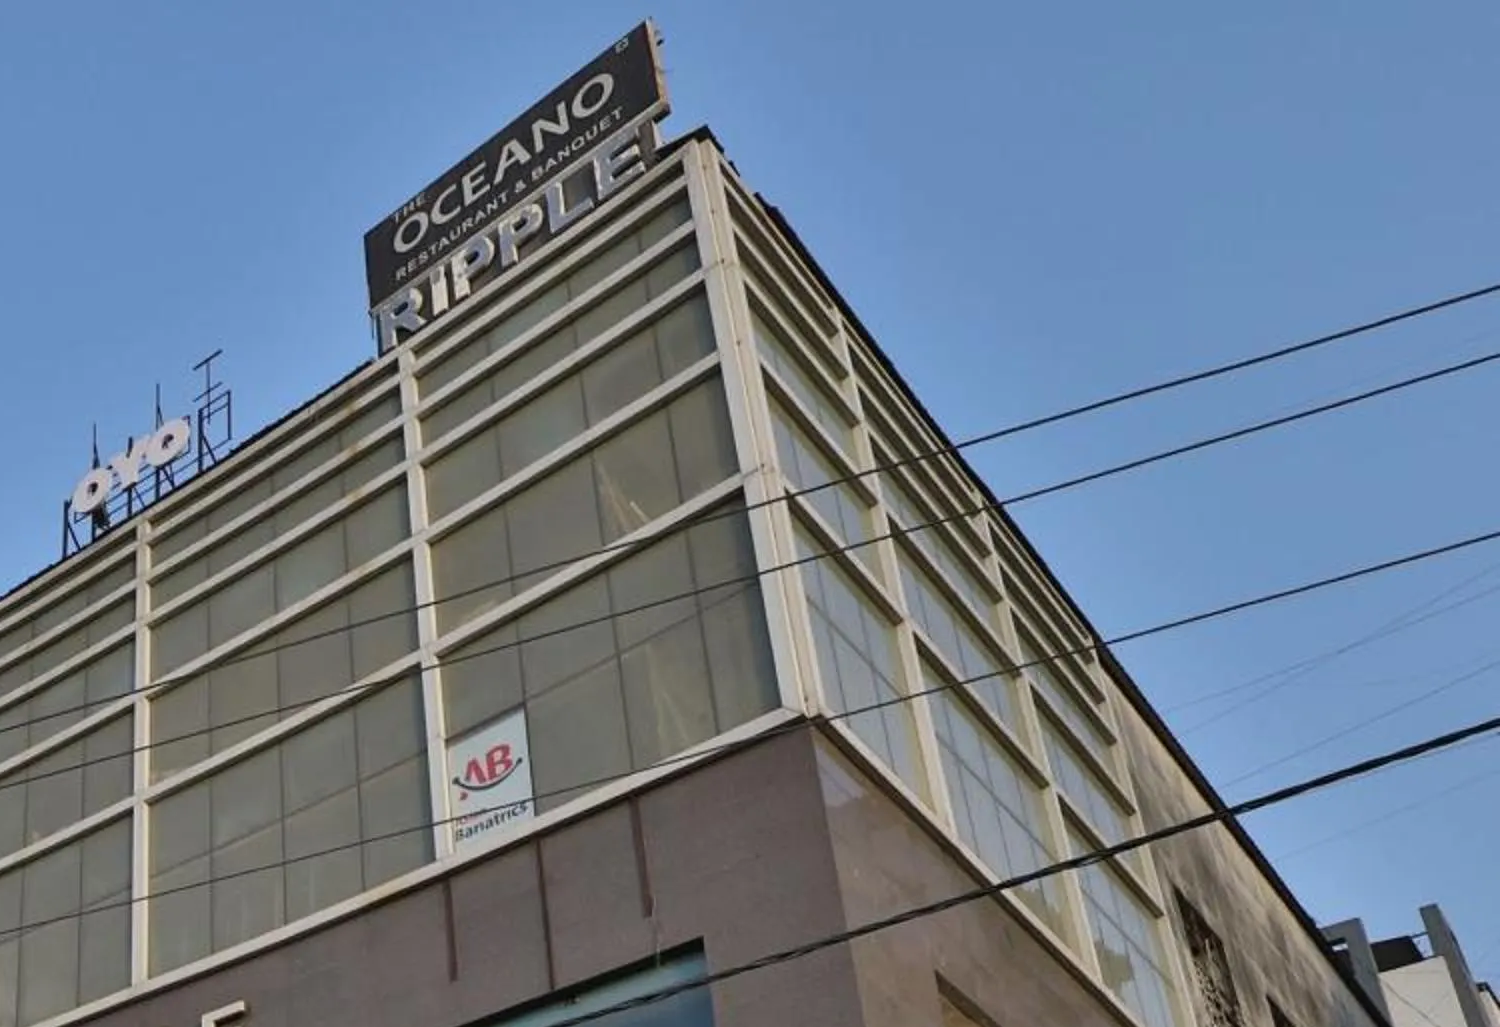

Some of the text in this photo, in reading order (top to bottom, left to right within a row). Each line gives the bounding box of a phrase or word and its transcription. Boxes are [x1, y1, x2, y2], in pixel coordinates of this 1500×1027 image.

[375, 124, 649, 350] RIPPLE
[393, 72, 615, 253] OCEANO
[395, 106, 624, 281] RESTAURANT & BANQUET
[70, 418, 191, 513] OYO
